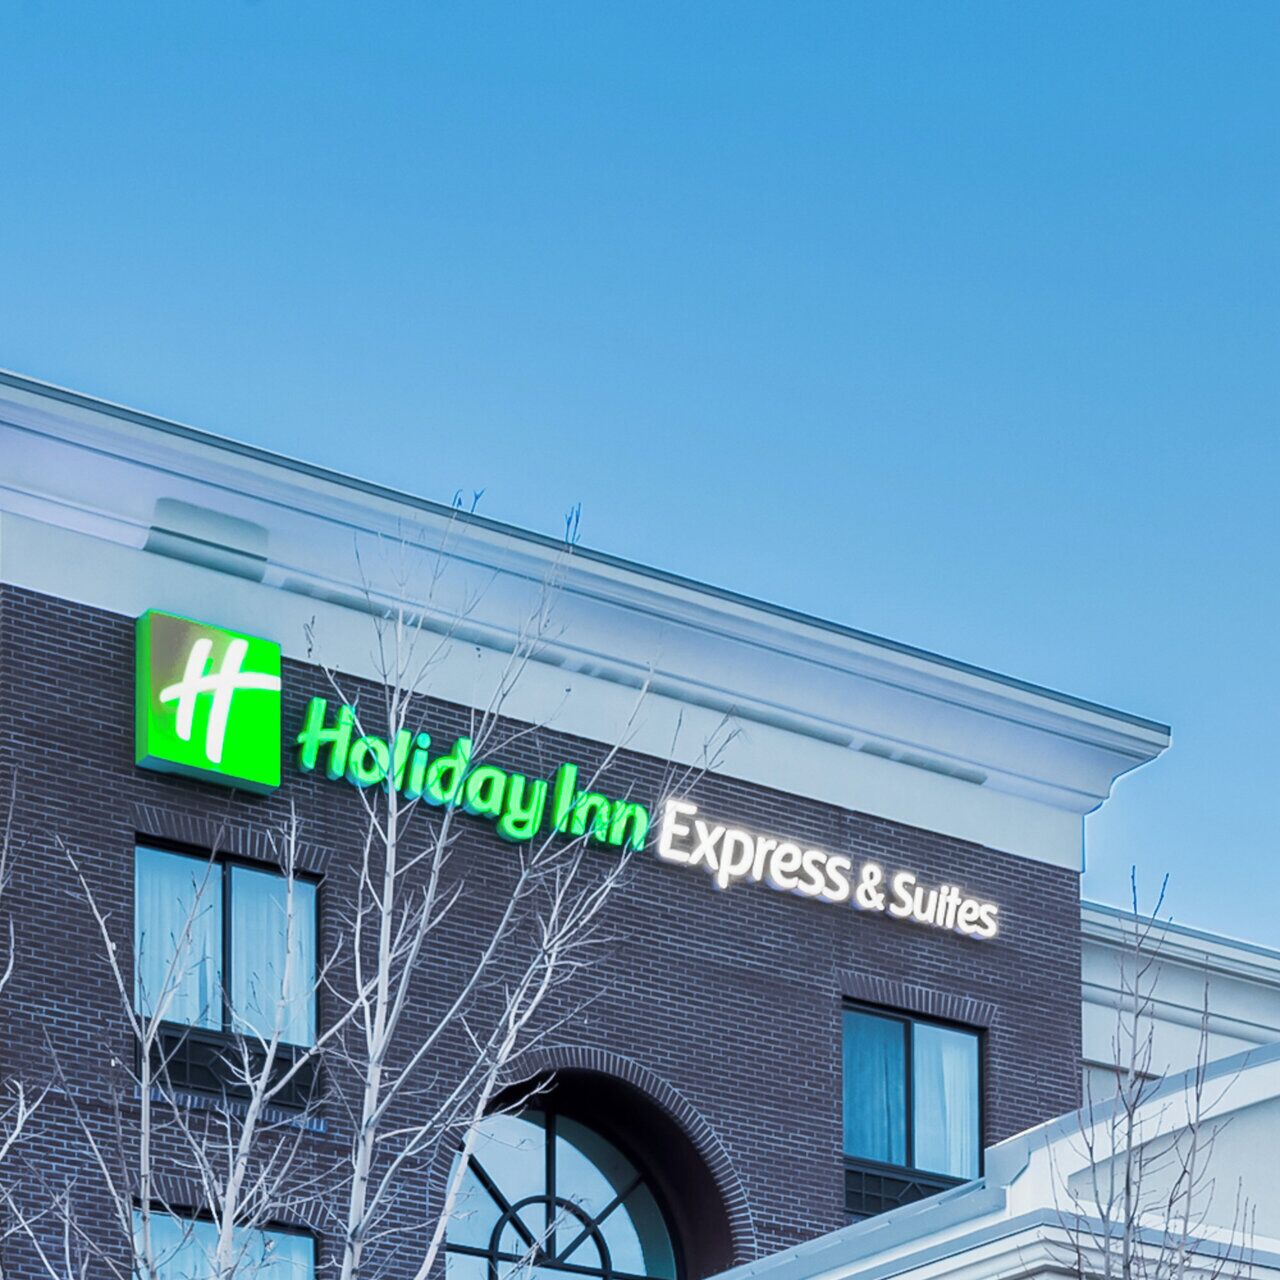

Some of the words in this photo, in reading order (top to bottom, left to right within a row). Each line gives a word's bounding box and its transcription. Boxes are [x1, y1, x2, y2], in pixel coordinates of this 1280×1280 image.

[297, 697, 547, 841] Holiday
[554, 763, 649, 851] Inn
[659, 799, 852, 901] Express
[855, 863, 885, 911] &
[889, 872, 998, 938] Suites
